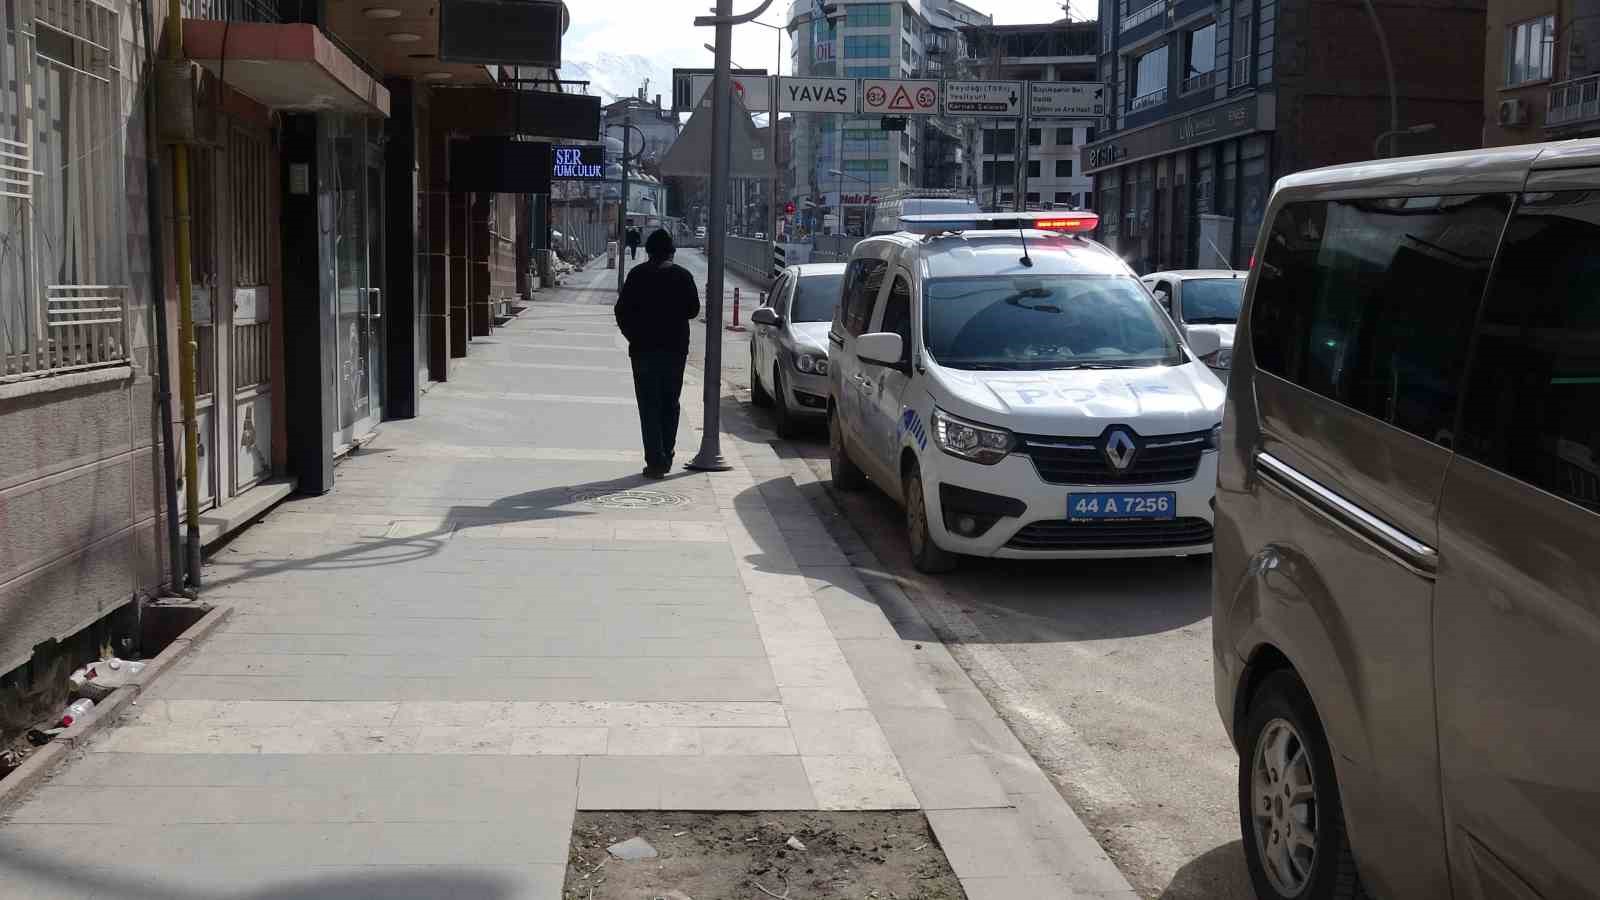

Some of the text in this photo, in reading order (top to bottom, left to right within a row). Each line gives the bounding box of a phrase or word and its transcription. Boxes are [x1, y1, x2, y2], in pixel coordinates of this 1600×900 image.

[788, 86, 846, 104] YAVAŞ
[1075, 496, 1169, 513] 44 A 7256
